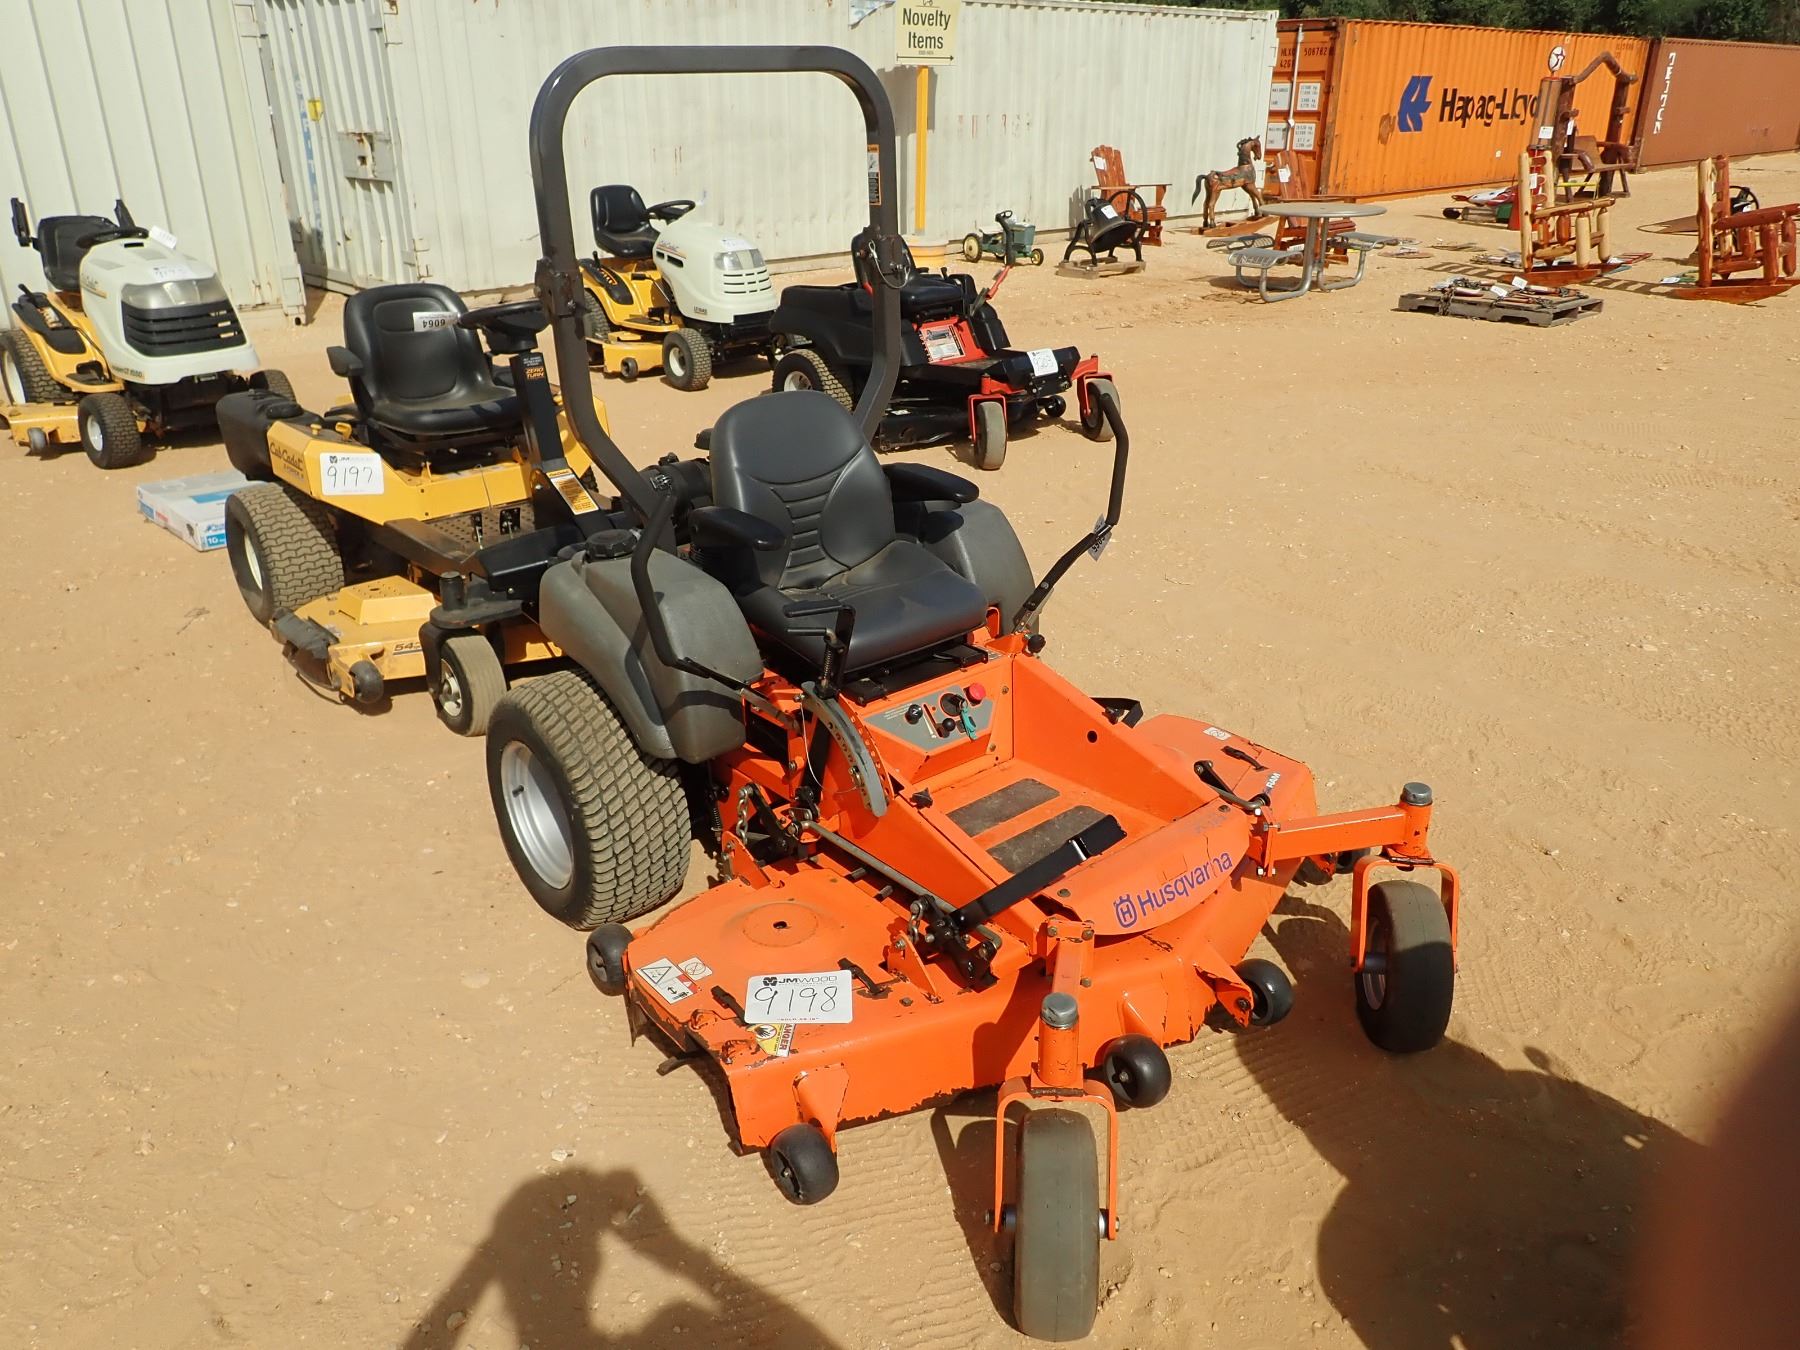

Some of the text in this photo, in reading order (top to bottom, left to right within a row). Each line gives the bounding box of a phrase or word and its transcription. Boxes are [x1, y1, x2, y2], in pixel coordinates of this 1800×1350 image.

[902, 8, 951, 30] Novelty
[908, 32, 944, 49] Items
[327, 465, 373, 488] 9197
[1136, 852, 1233, 917] Husqvarna
[754, 985, 838, 1015] 9198
[778, 1023, 793, 1051] ANGER
